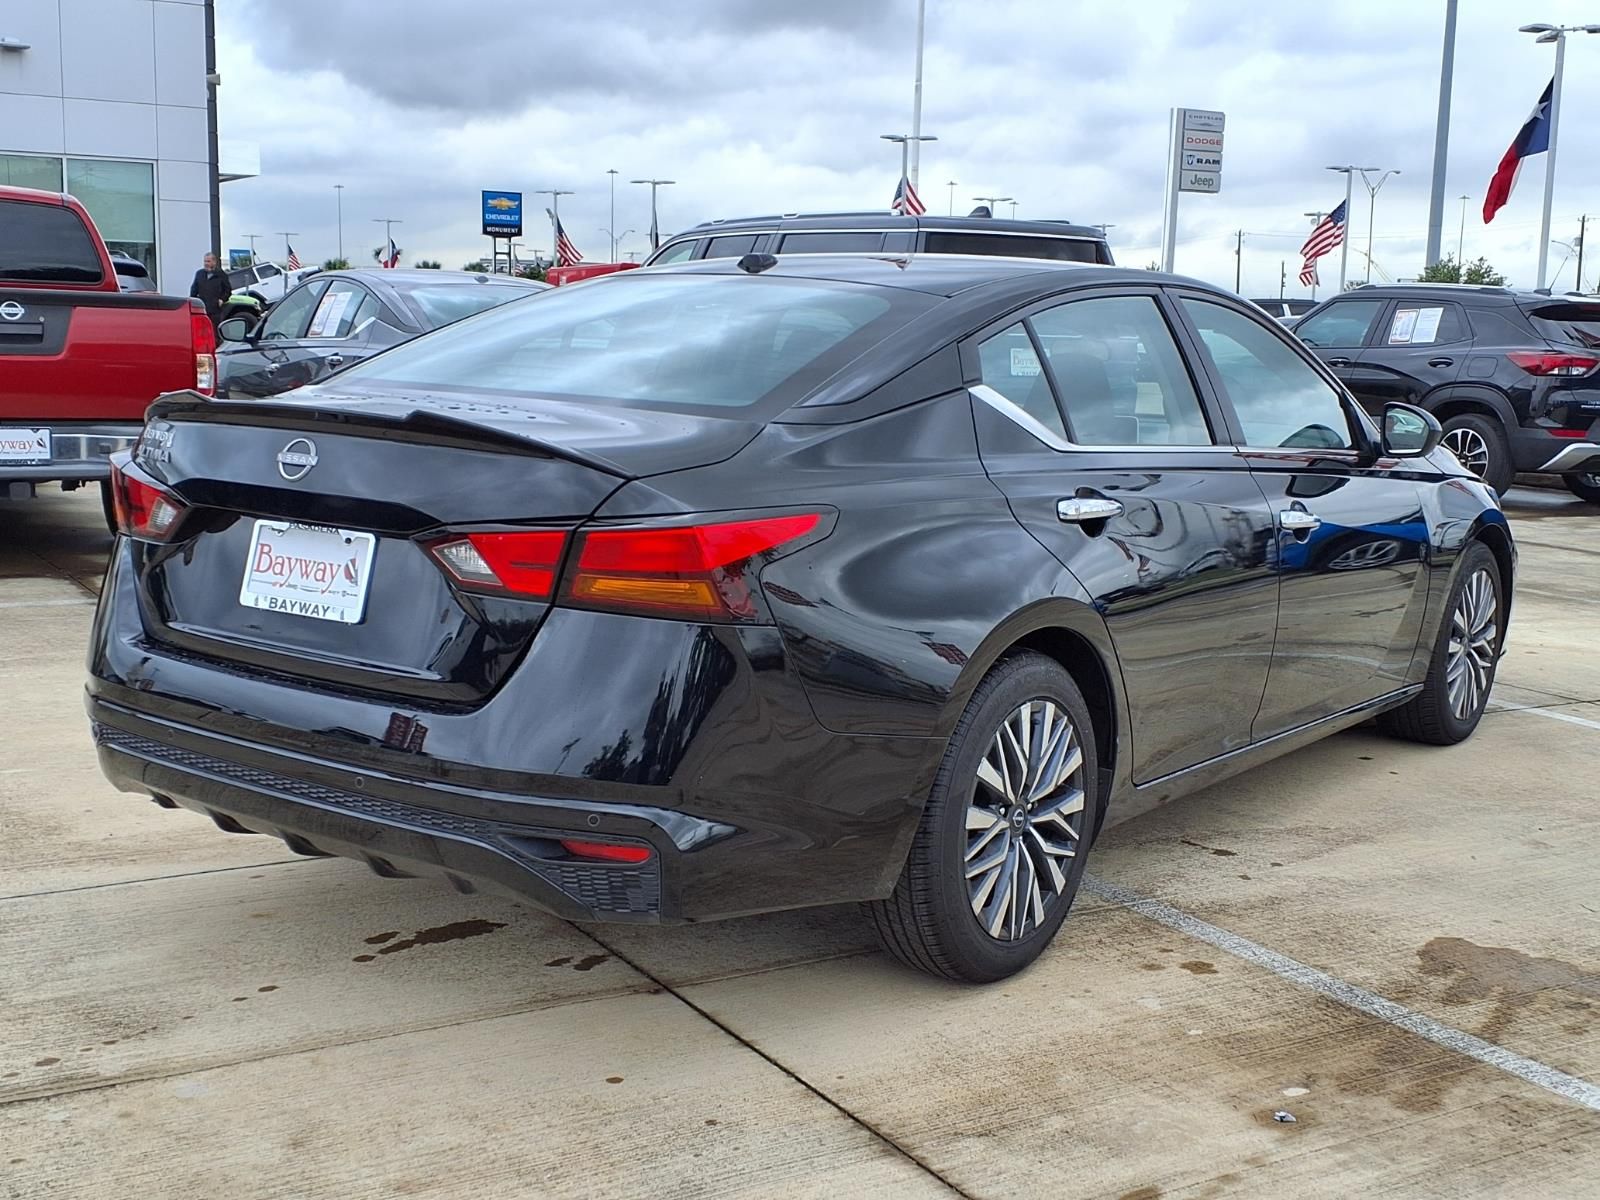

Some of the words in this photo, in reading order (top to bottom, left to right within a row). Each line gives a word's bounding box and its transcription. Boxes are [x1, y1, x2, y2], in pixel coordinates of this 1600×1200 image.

[1187, 137, 1222, 146] DODGE
[1196, 158, 1220, 166] RAM
[1190, 174, 1214, 188] Jeep
[254, 543, 341, 594] Bayway
[268, 597, 331, 617] BAYWAY
